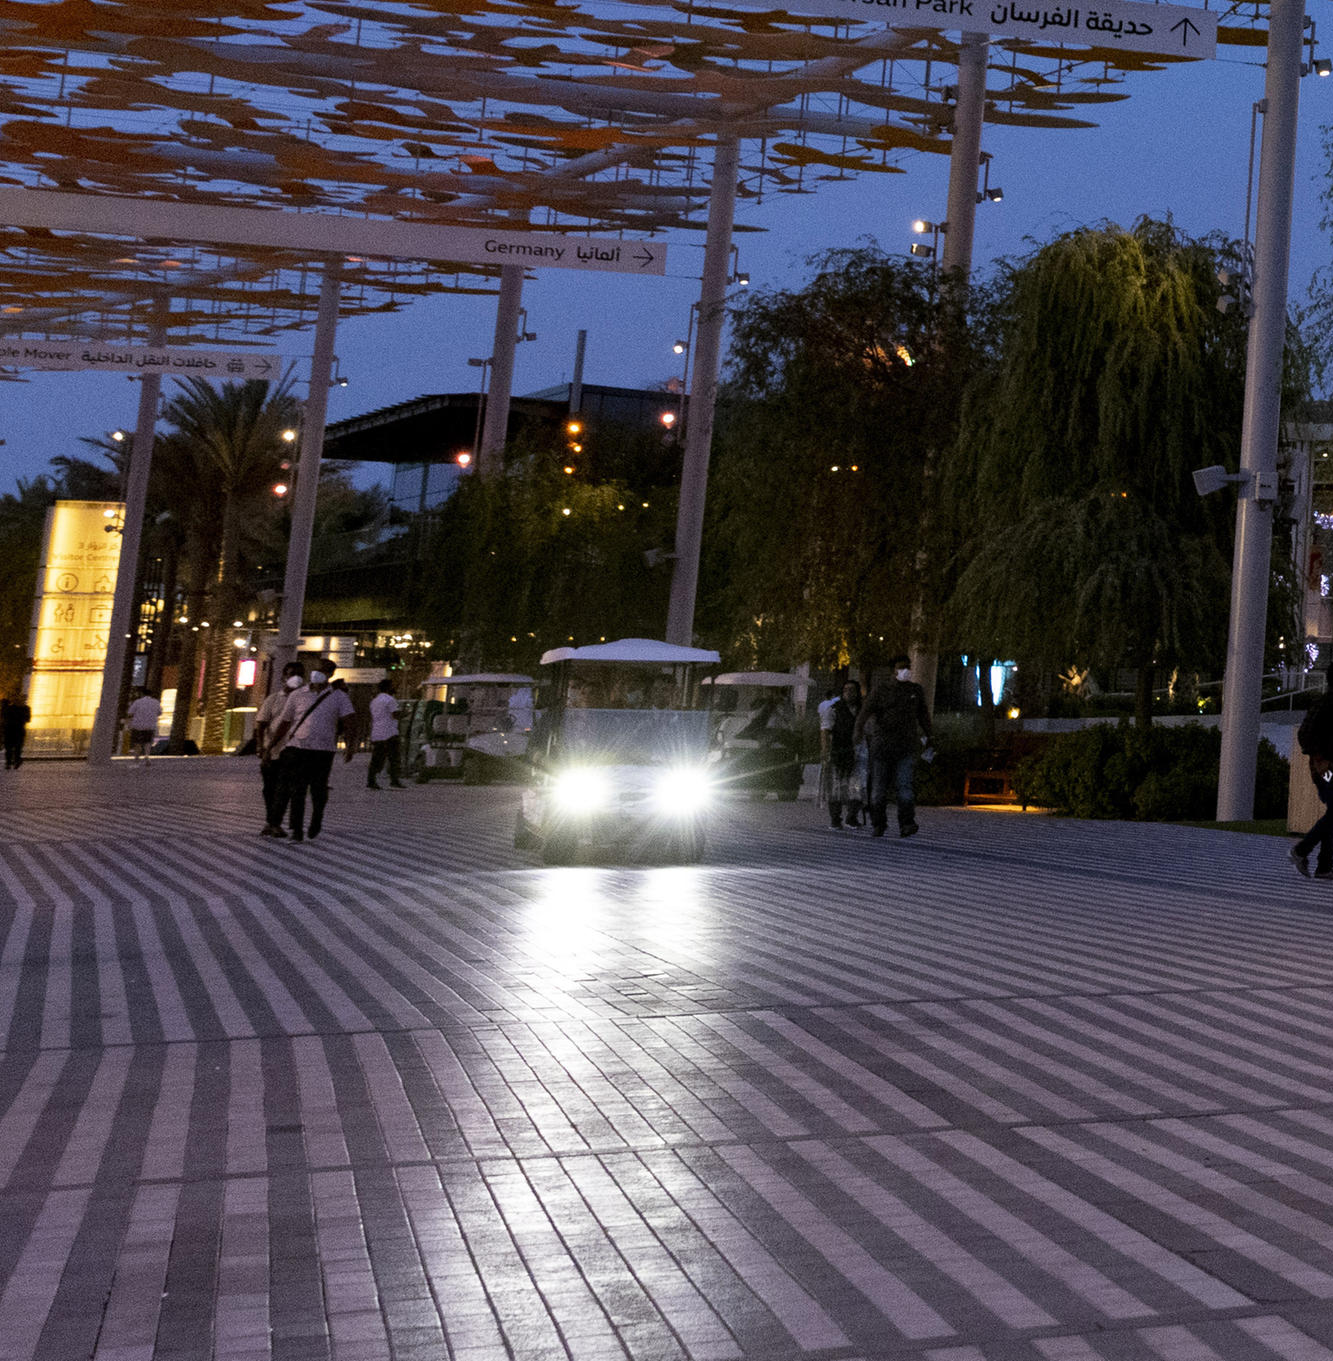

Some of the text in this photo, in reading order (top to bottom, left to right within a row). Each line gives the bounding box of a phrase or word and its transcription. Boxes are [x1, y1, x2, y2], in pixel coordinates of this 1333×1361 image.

[990, 1, 1155, 38] حديقة الفرسان
[484, 239, 567, 262] Germany
[576, 245, 622, 264] ألمانيا
[24, 348, 71, 360] Mover
